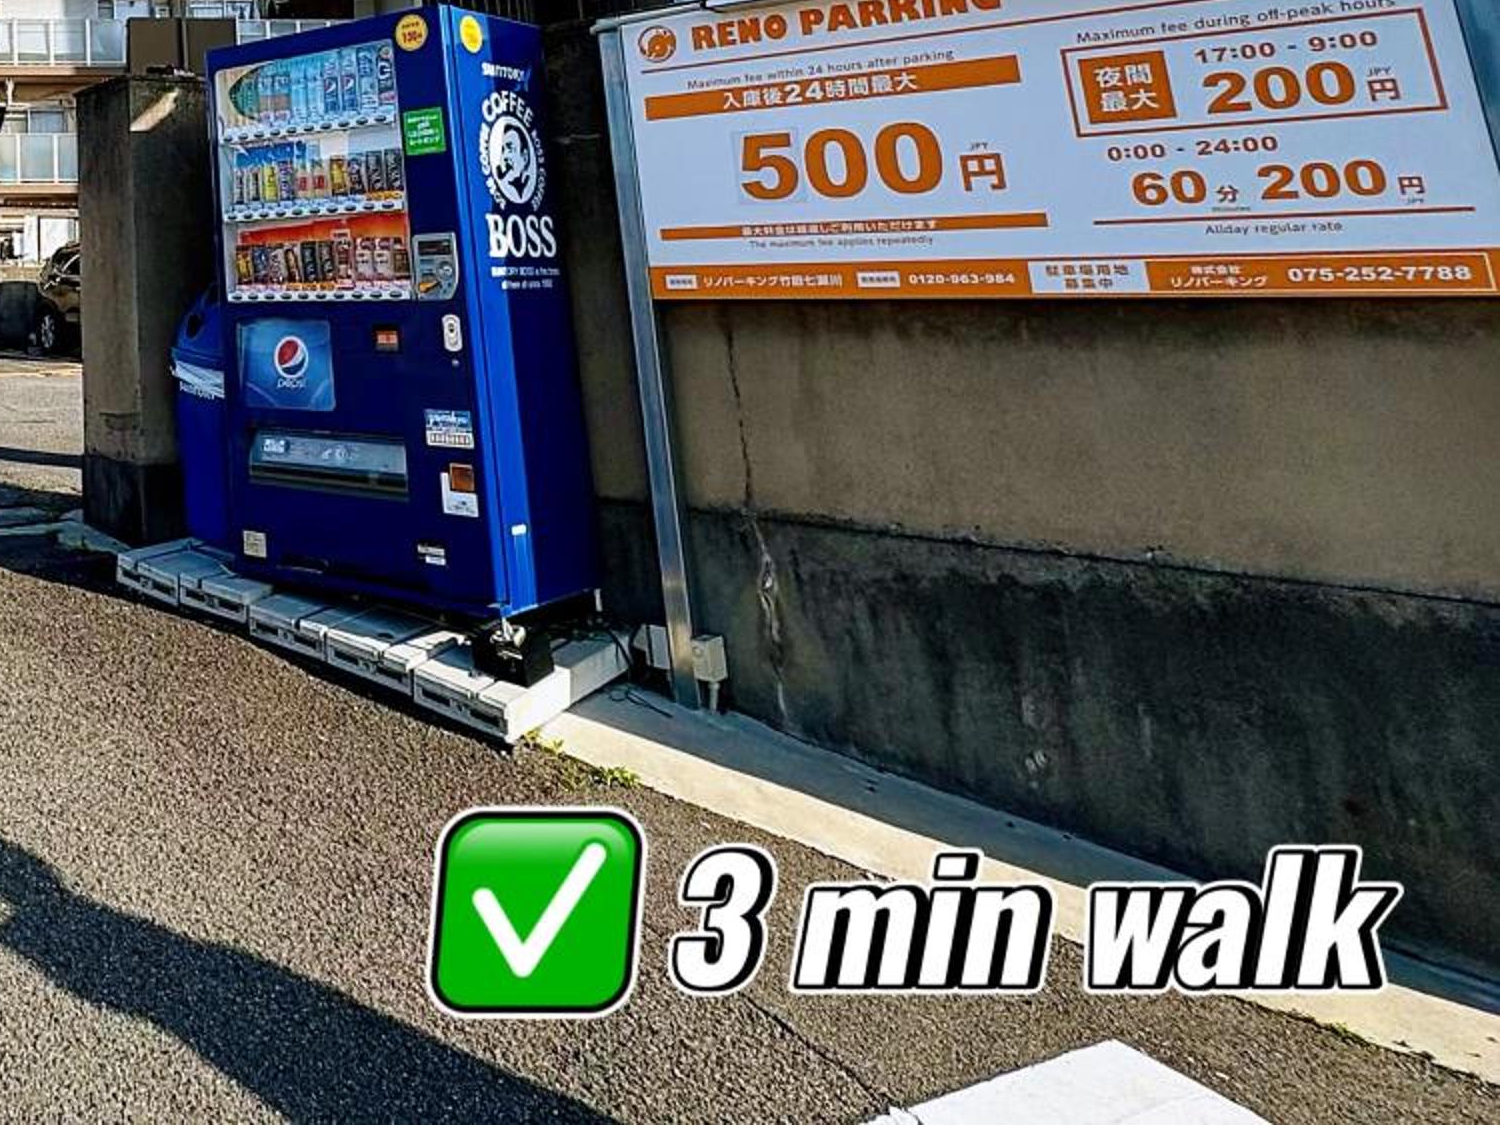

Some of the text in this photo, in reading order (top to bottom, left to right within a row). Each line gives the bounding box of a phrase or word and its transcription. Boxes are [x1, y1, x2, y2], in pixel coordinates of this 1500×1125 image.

[691, 13, 788, 52] RENO
[1076, 24, 1156, 44] Maximum
[1161, 20, 1188, 34] fee
[1195, 12, 1251, 33] during
[1257, 2, 1333, 24] off-peak
[1195, 41, 1276, 64] 17:00
[1309, 30, 1378, 53] 9:00
[687, 75, 741, 89] Maximum
[808, 65, 823, 77] 24
[827, 60, 863, 74] hours
[867, 55, 897, 69] after
[903, 50, 954, 67] parking
[1093, 62, 1153, 88] 夜間
[1203, 61, 1357, 114] 200
[481, 90, 534, 128] COFFEE
[1101, 88, 1159, 112] 最大
[741, 122, 943, 201] 500
[1107, 143, 1166, 162] 0:00
[1196, 136, 1279, 156] 24:00
[1131, 170, 1208, 206] 60
[1257, 159, 1388, 201] 200
[1398, 175, 1426, 194] 円
[485, 213, 557, 258] BOSS
[1255, 223, 1306, 236] regular
[1311, 221, 1343, 232] rate
[1287, 264, 1472, 283] 075-252-7788
